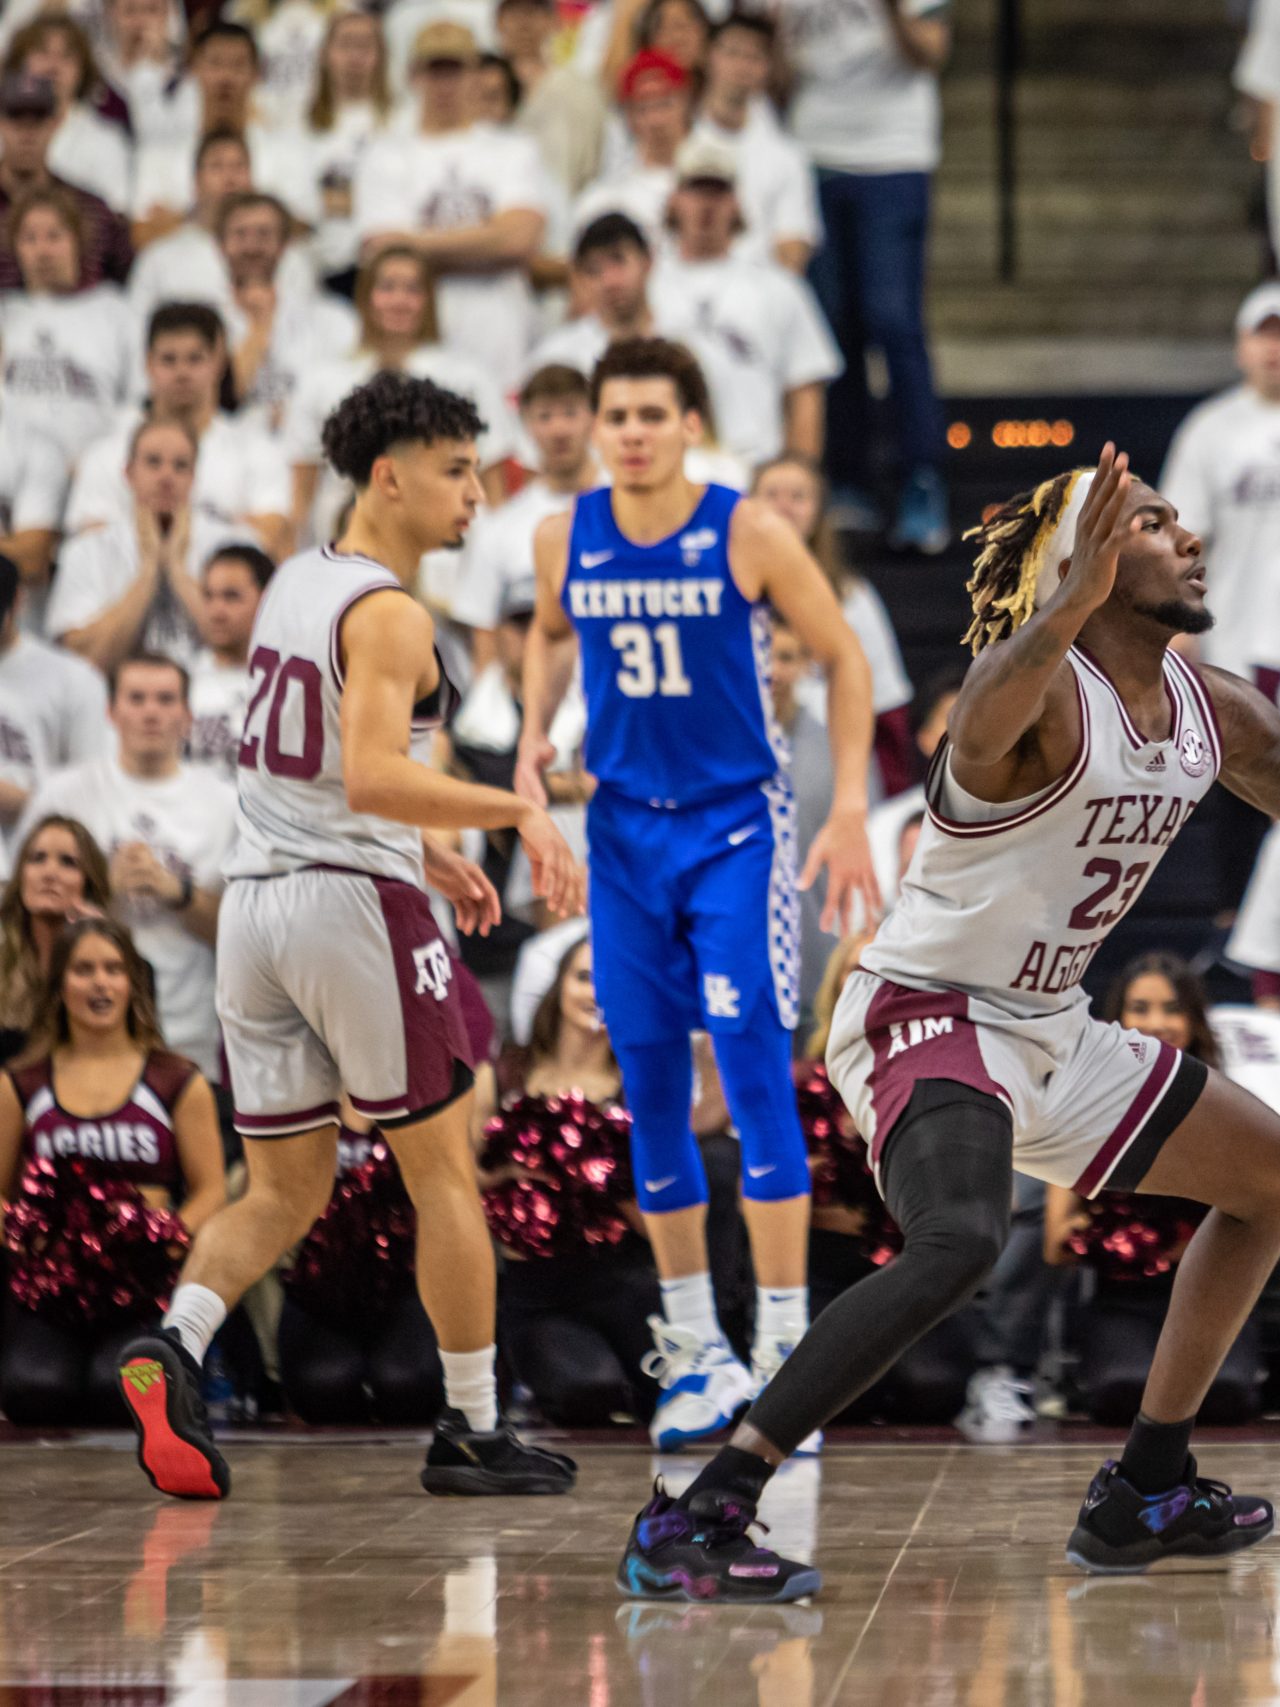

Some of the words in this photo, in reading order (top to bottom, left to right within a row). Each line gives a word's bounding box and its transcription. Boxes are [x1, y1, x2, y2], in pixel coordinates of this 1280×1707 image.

[569, 577, 724, 617] KENTUCKY
[610, 622, 691, 698] 31
[238, 645, 324, 783] 20
[1067, 857, 1150, 931] 23
